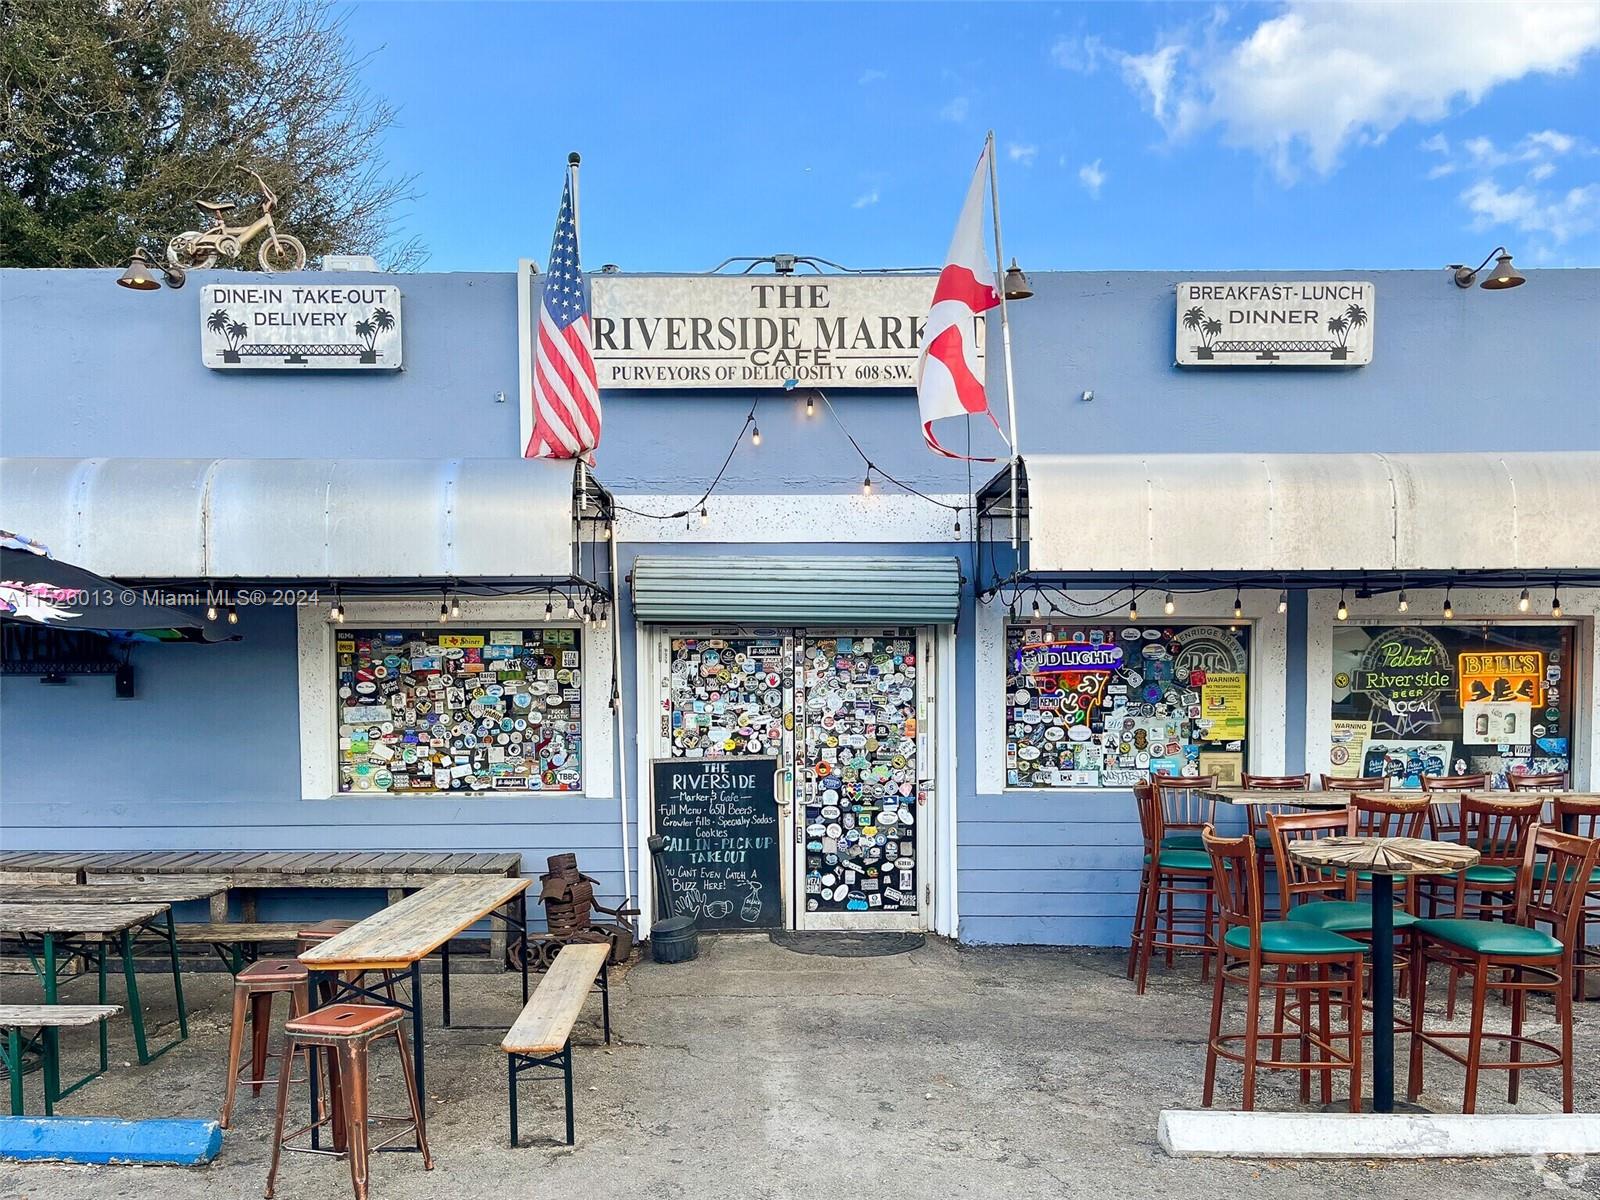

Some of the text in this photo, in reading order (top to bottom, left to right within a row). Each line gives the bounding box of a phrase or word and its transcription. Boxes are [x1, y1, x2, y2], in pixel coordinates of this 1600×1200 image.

[213, 289, 387, 304] DINE-IN TAKE-OUT
[751, 285, 830, 309] THE
[254, 312, 347, 326] DELIVERY
[1229, 310, 1319, 324] DINNER
[592, 315, 803, 351] RIVERSIDE
[750, 350, 832, 366] CAFE
[612, 365, 913, 381] PURVEYORS OF DELICIOSITY 608 S.W.
[1030, 650, 1115, 667] UD LIGHT
[1381, 642, 1436, 668] Pabst
[1465, 655, 1535, 674] BELL'S
[1366, 671, 1450, 689] Riverside
[1392, 689, 1424, 699] BEER
[1334, 722, 1367, 730] WARNING
[702, 763, 730, 773] THE
[673, 774, 756, 790] RIVERSIDE
[720, 791, 739, 802] Cafe
[659, 803, 676, 816] Full
[680, 804, 702, 815] Menu
[662, 816, 693, 827] Growler
[717, 816, 750, 828] Specialty
[695, 827, 728, 838] Cookies
[700, 867, 721, 879] EVEN
[725, 867, 746, 880] CATCH
[750, 869, 757, 879] A
[672, 877, 726, 892] BUZZ HERE!
